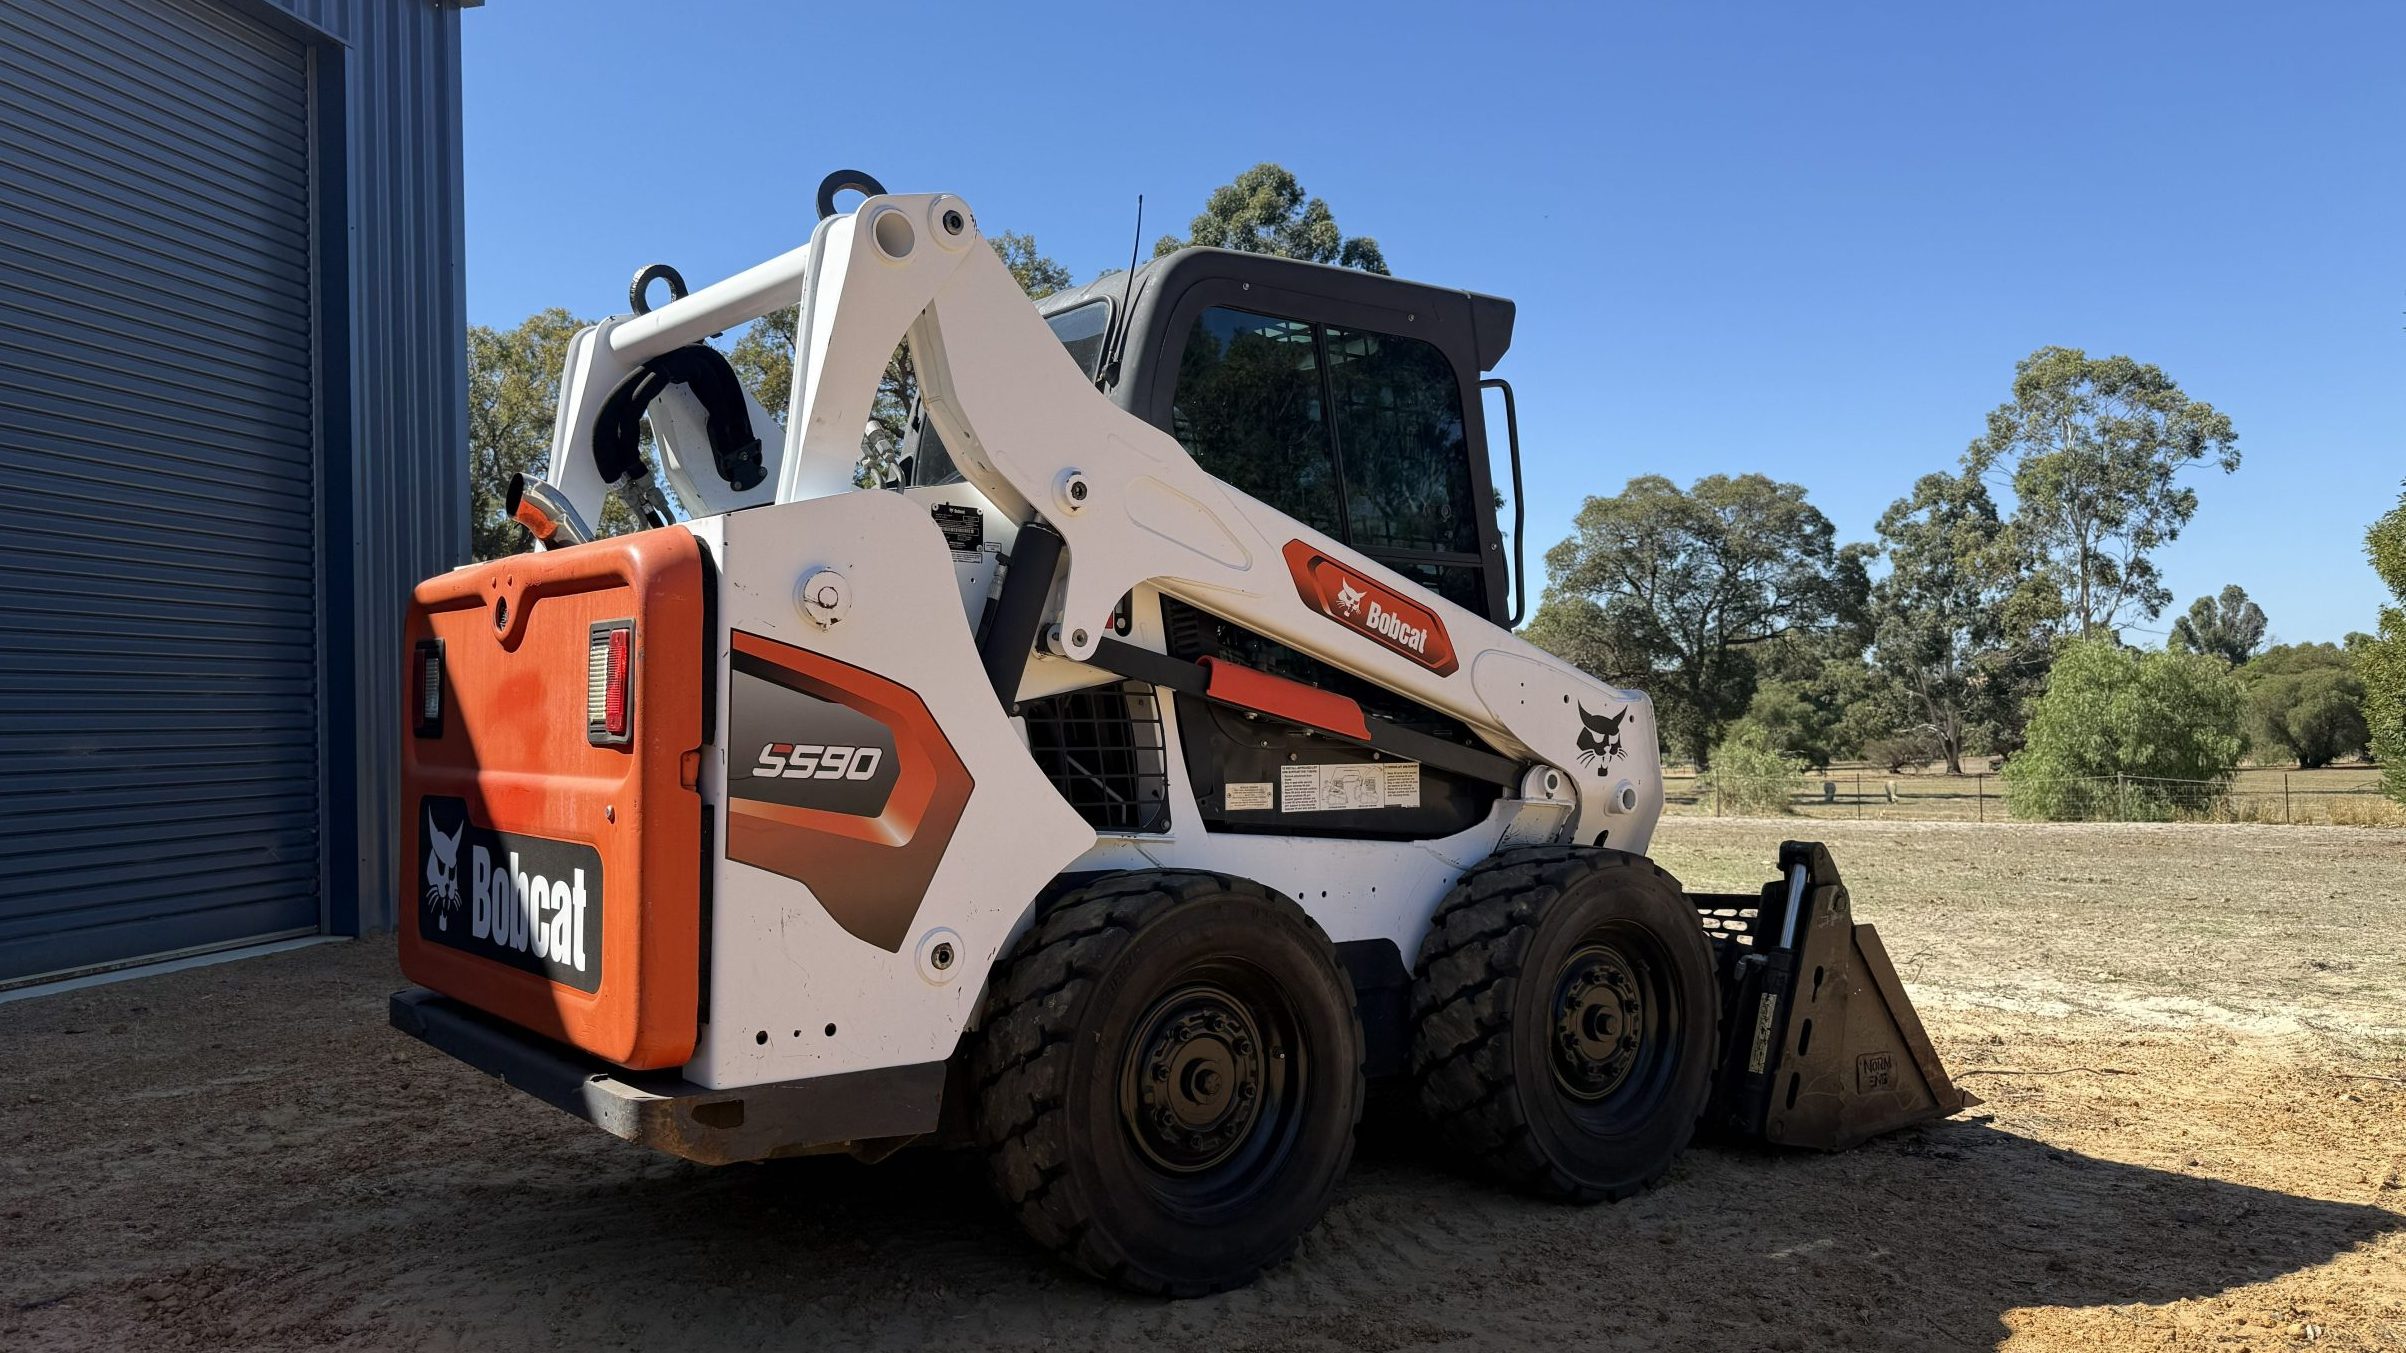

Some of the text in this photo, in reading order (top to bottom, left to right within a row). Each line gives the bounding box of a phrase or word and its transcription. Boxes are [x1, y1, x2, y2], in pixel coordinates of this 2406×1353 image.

[1366, 601, 1428, 654] Bobcat
[752, 743, 883, 781] S590
[472, 844, 587, 972] Bobcat
